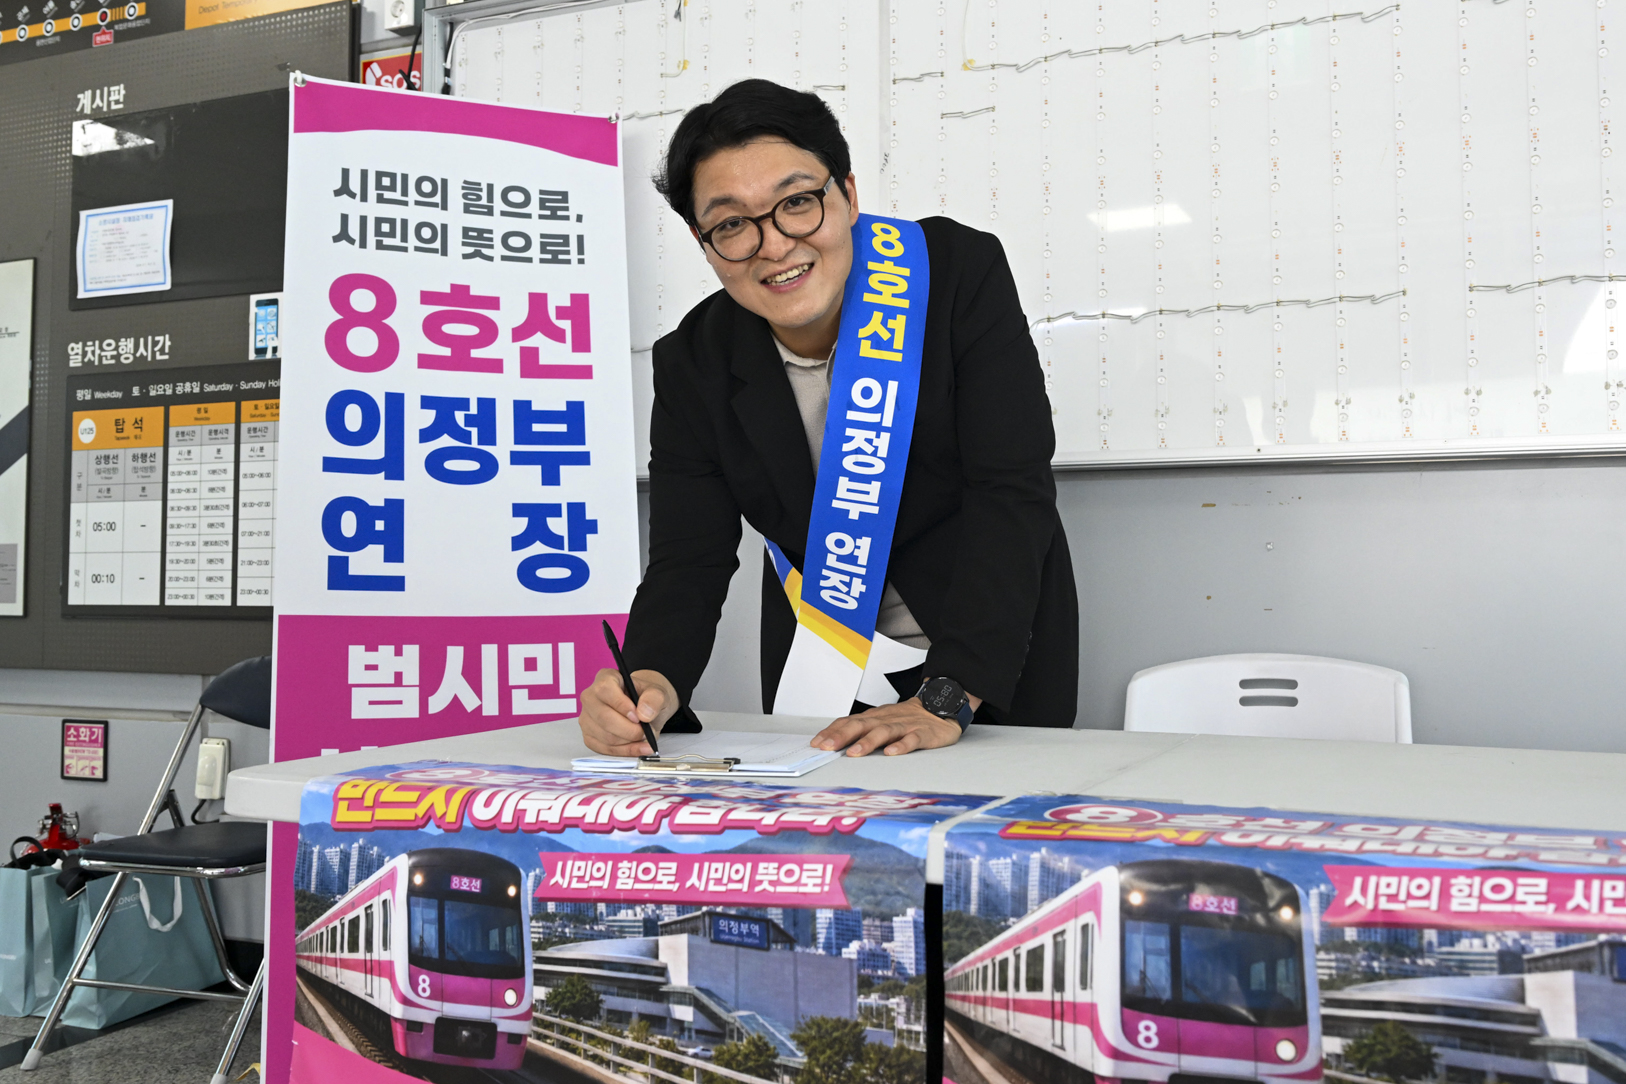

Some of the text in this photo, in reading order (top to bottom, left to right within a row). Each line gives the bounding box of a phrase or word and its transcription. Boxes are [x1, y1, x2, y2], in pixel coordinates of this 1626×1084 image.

[380, 70, 421, 90] SOS
[76, 84, 126, 114] 게시판
[333, 167, 583, 223] 시민의 힘으로,
[332, 213, 585, 265] 시민의 뜻으로!
[324, 273, 593, 379] 8호선
[67, 334, 171, 367] 열차운행시간
[76, 388, 123, 401] 평일 Weekday
[148, 383, 173, 396] 일요일
[175, 381, 200, 394] 공휴일
[203, 382, 233, 393] Saturday
[240, 380, 266, 390] Sunday
[819, 222, 911, 610] 8호선 의정부 연장
[322, 389, 591, 486] 의정부
[95, 454, 119, 465] 상행선
[131, 452, 156, 463] 하행선
[93, 521, 116, 532] 05:00
[91, 574, 115, 584] 00:10
[348, 642, 577, 719] 범시민
[67, 727, 102, 742] 소화기
[335, 779, 480, 823] 반드시
[451, 875, 482, 893] 8호선
[550, 860, 834, 895] 시민의 힘으로, 시민의 뜻으로!
[1344, 875, 1443, 912] 시민의
[1449, 875, 1557, 915] 힘으로,
[719, 918, 760, 937] 의정부역
[417, 974, 431, 997] 8
[1137, 1019, 1160, 1049] 8
